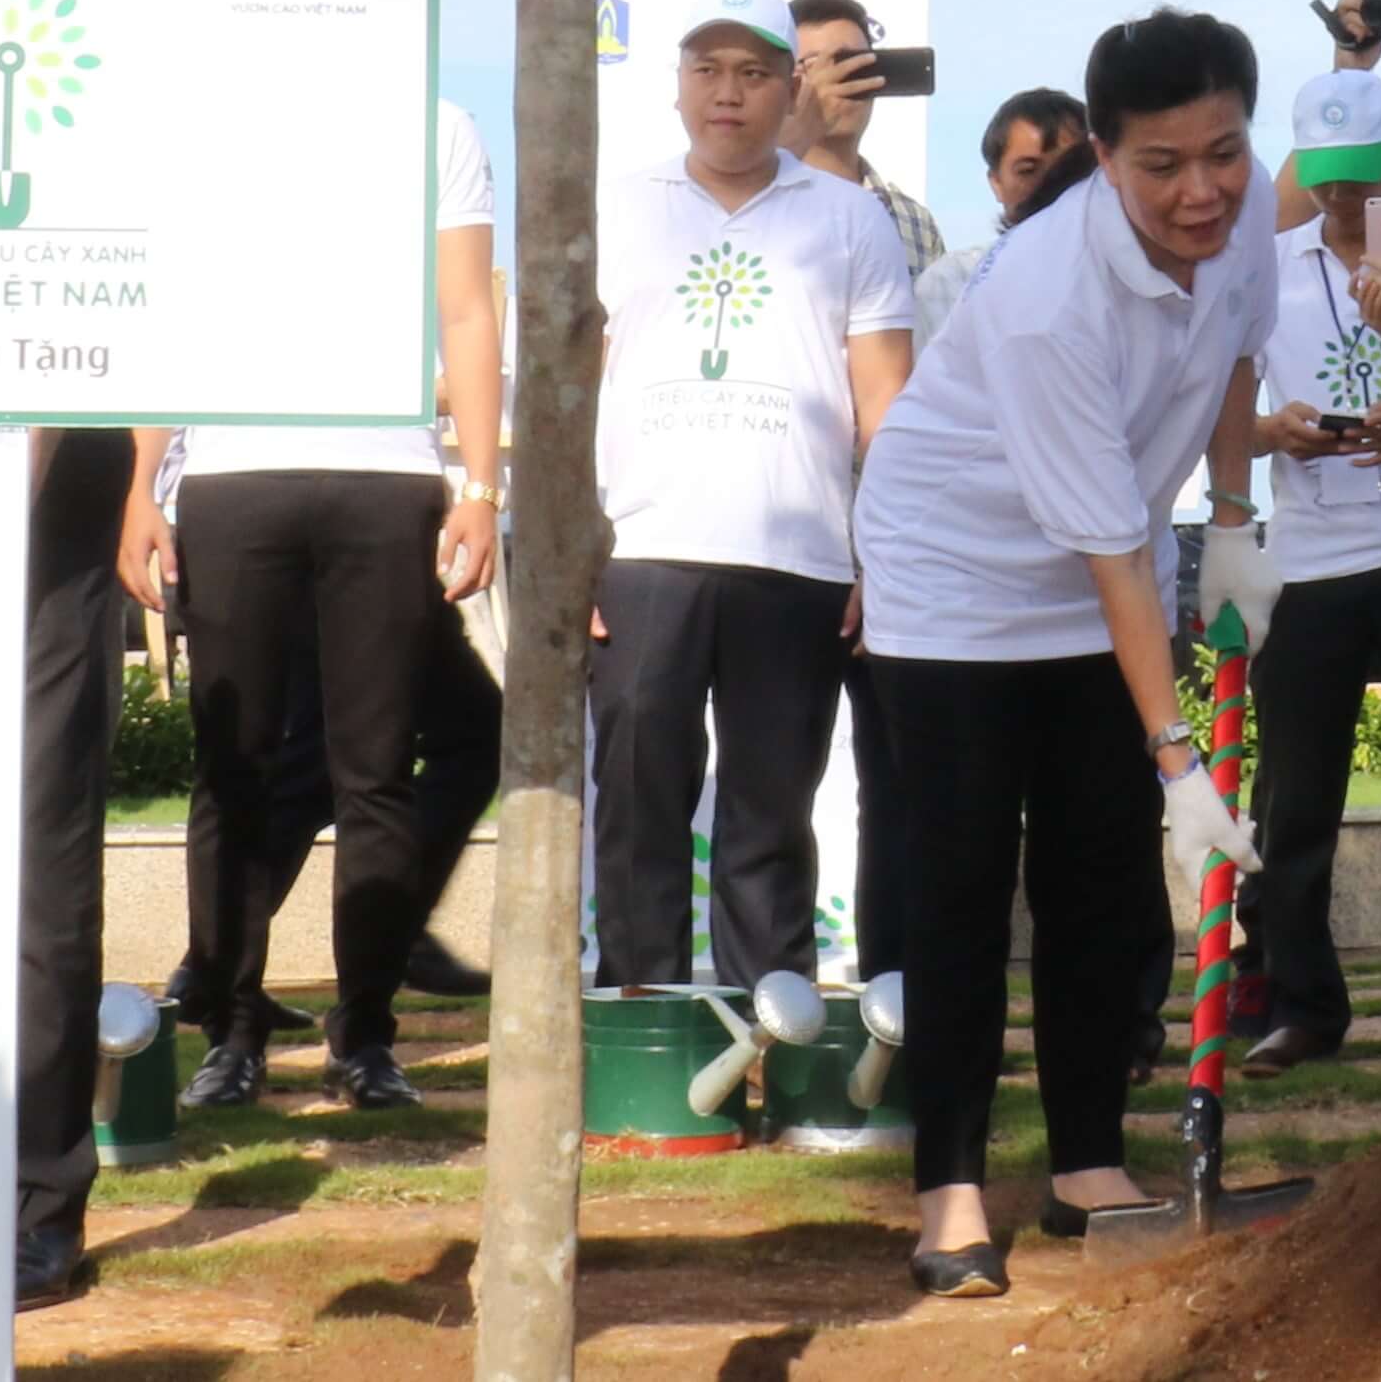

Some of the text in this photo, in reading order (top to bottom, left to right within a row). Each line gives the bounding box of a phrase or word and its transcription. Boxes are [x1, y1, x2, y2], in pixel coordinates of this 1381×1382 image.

[23, 240, 71, 264] CÂY
[81, 244, 147, 264] XANH
[62, 279, 148, 308] NAM
[11, 336, 110, 378] Tặng
[745, 392, 790, 411] XANH
[743, 414, 789, 437] NAM
